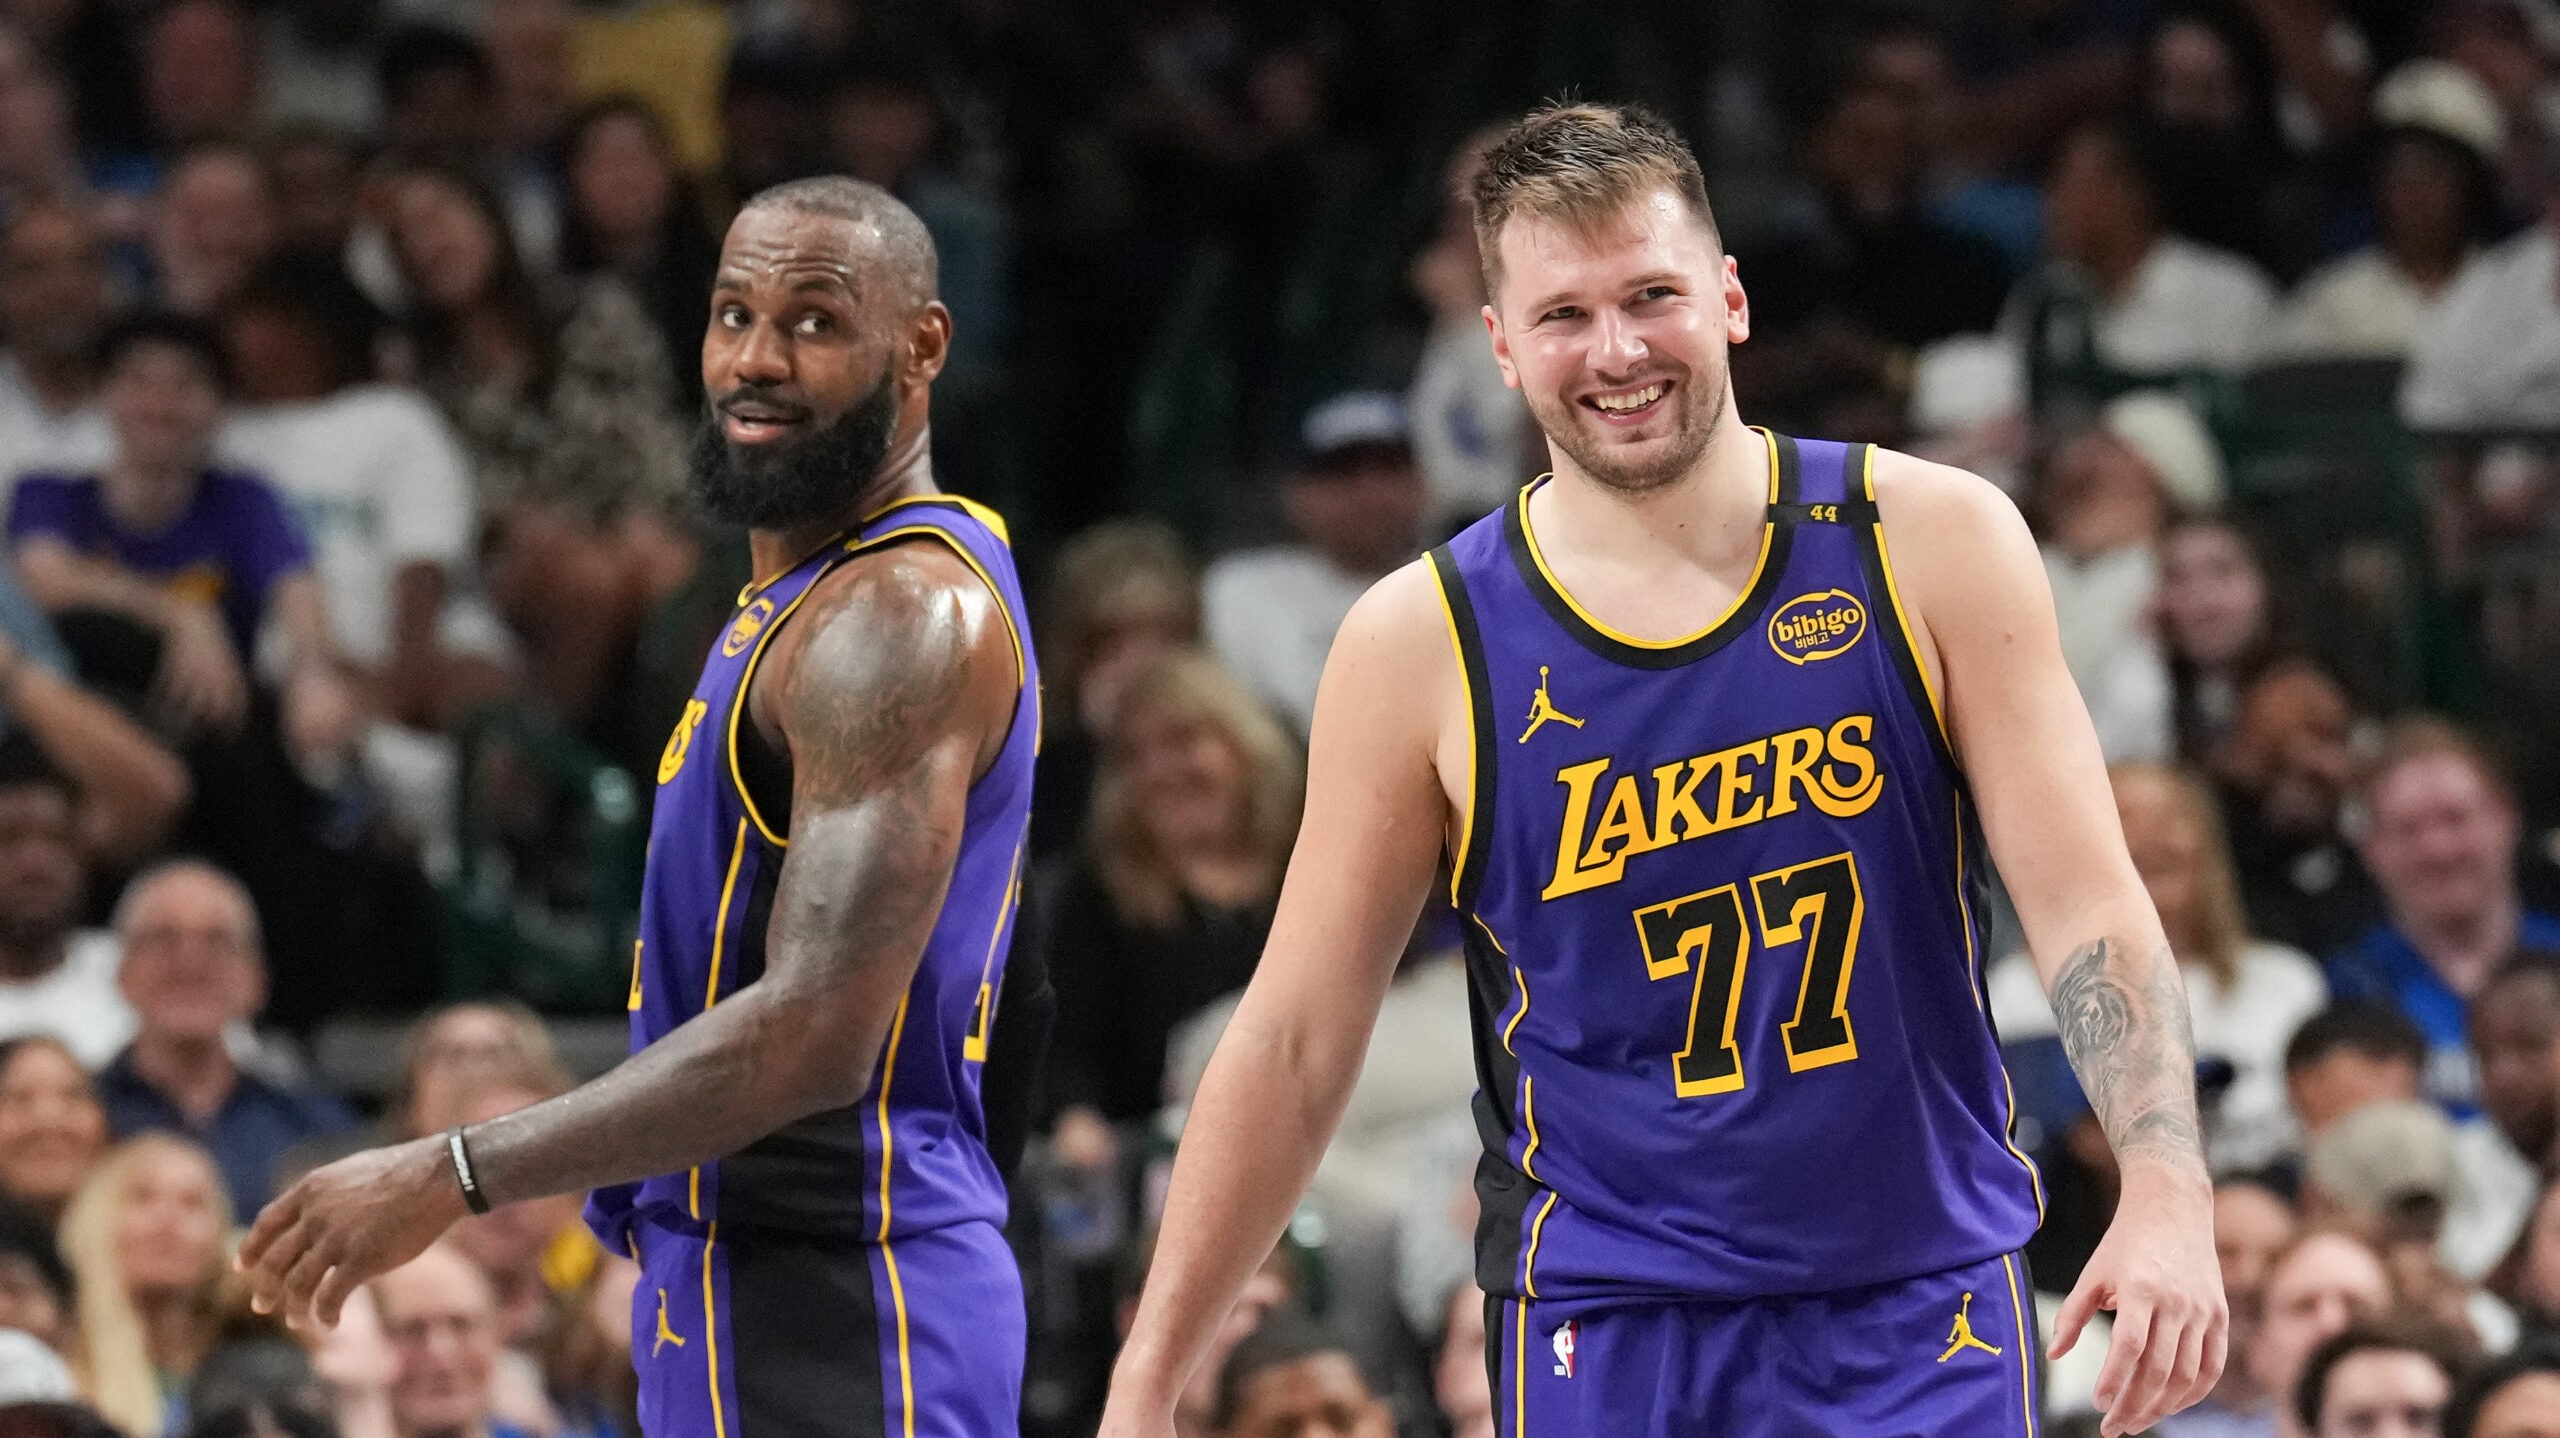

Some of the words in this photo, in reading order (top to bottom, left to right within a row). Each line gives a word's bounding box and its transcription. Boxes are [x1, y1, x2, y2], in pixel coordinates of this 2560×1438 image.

[1810, 505, 1837, 522] 44
[1776, 608, 1859, 642] bibigo
[1795, 632, 1830, 649] 비비고
[1541, 714, 1885, 902] LAKERS
[1632, 851, 1865, 1099] 77
